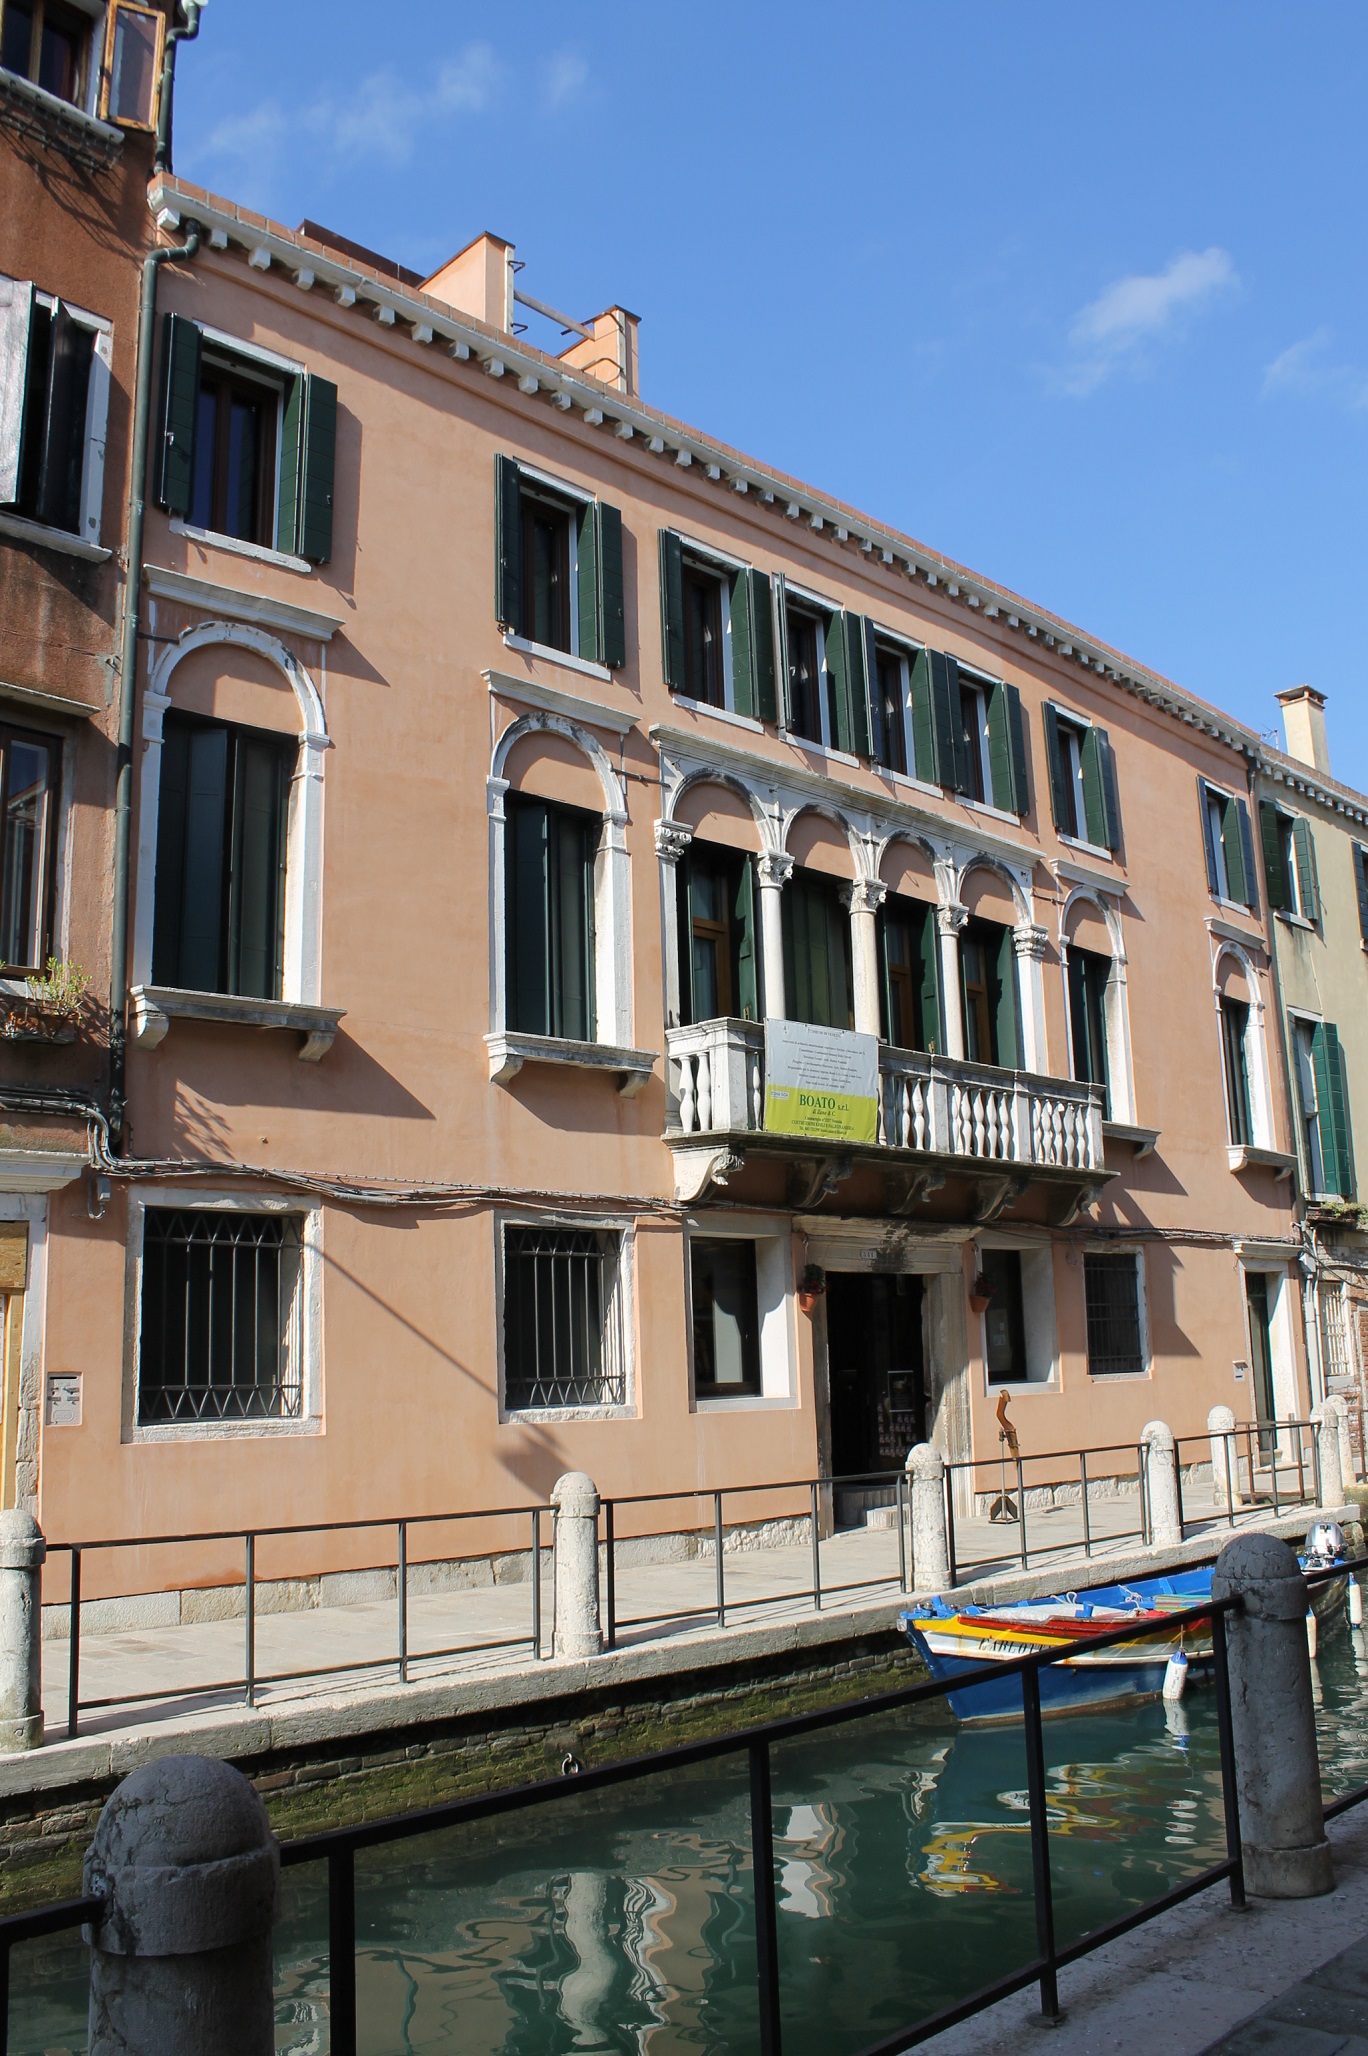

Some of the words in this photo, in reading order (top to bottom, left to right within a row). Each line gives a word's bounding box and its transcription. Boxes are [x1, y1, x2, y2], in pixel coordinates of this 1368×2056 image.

[799, 1094, 836, 1110] BOATO
[837, 1103, 850, 1112] s.r.l.
[978, 1637, 1051, 1656] CARLOTT
